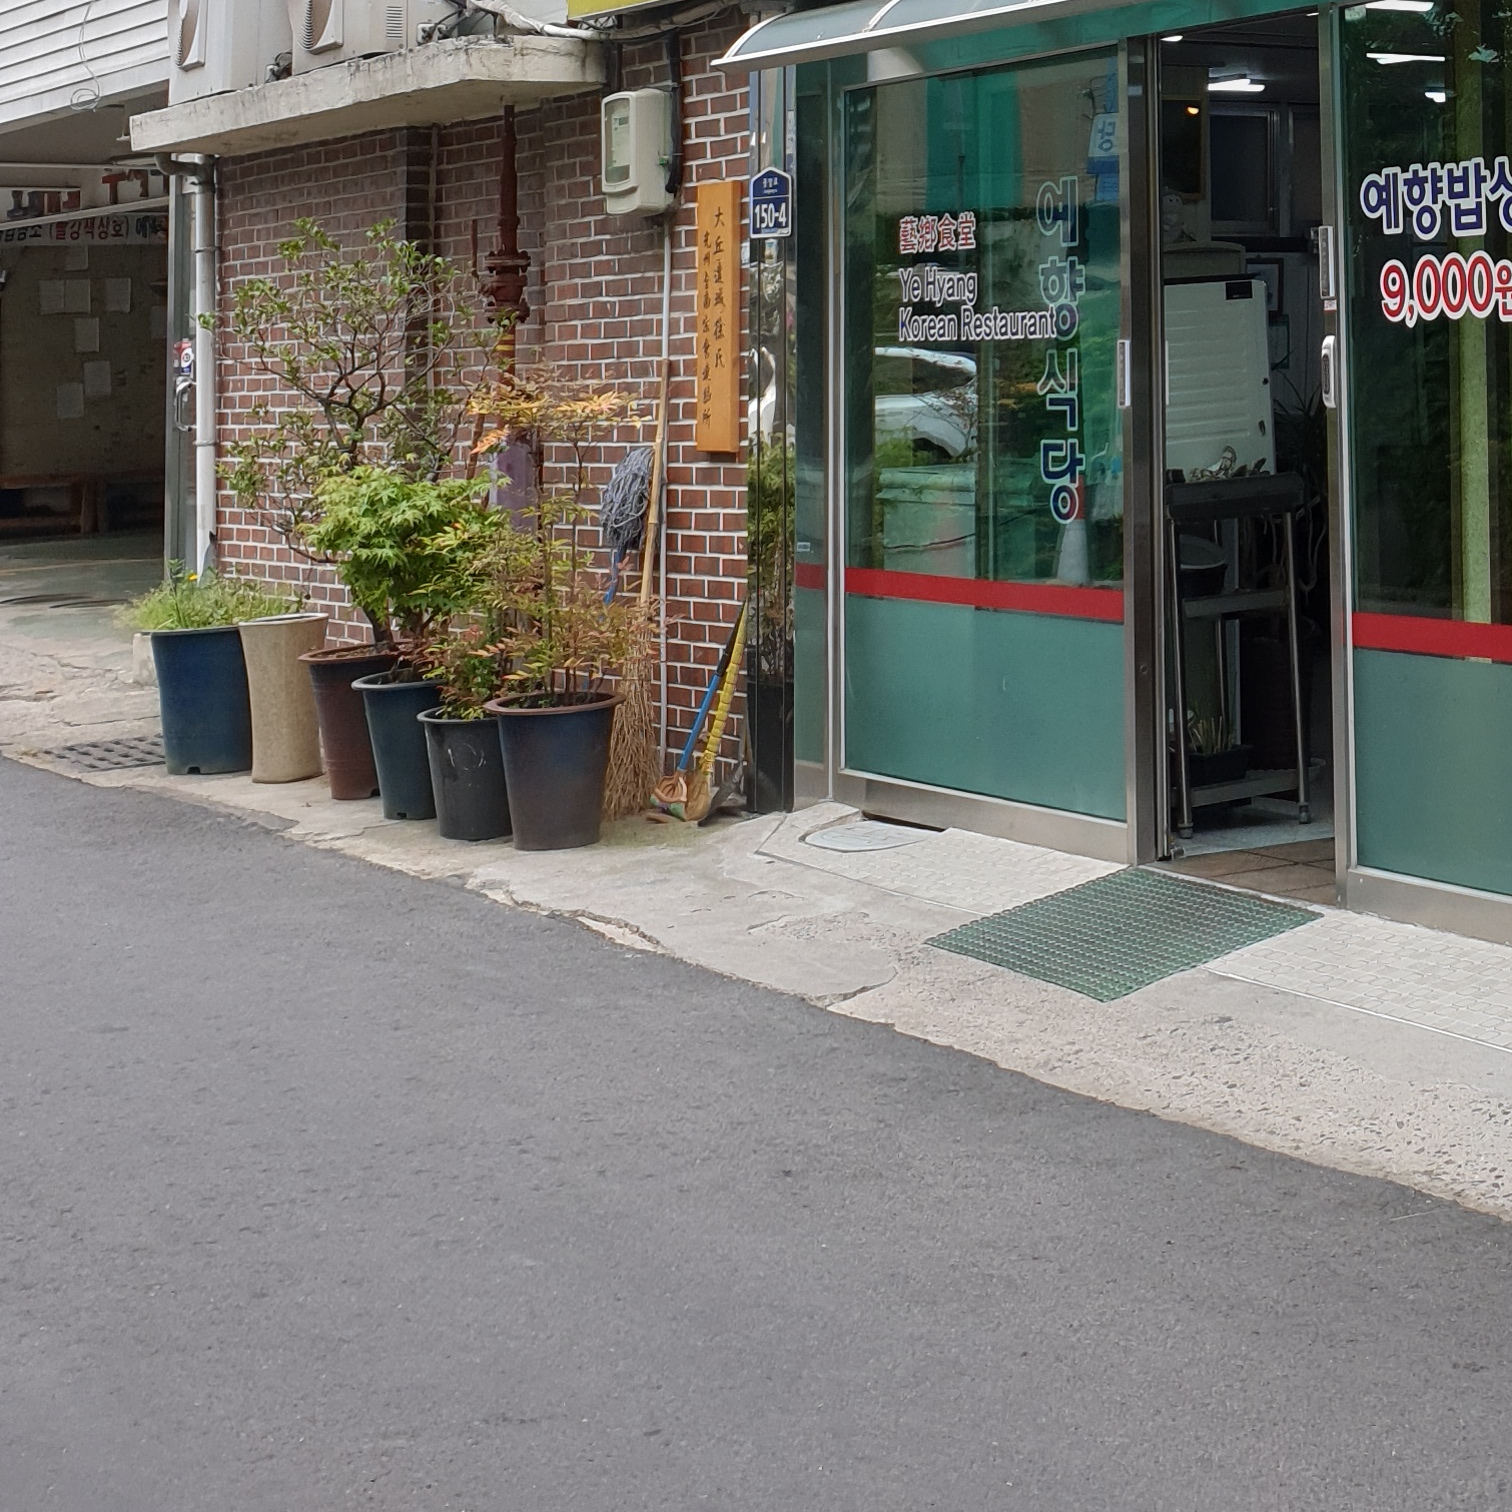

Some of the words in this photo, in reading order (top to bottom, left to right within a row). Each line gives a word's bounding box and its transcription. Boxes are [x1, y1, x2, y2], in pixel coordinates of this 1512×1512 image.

[755, 202, 787, 228] 150-4
[899, 267, 922, 302] Ye
[924, 266, 977, 307] Hyang
[899, 306, 957, 341] Korean
[961, 305, 1057, 340] Restaurant
[1036, 175, 1086, 524] 예향식당
